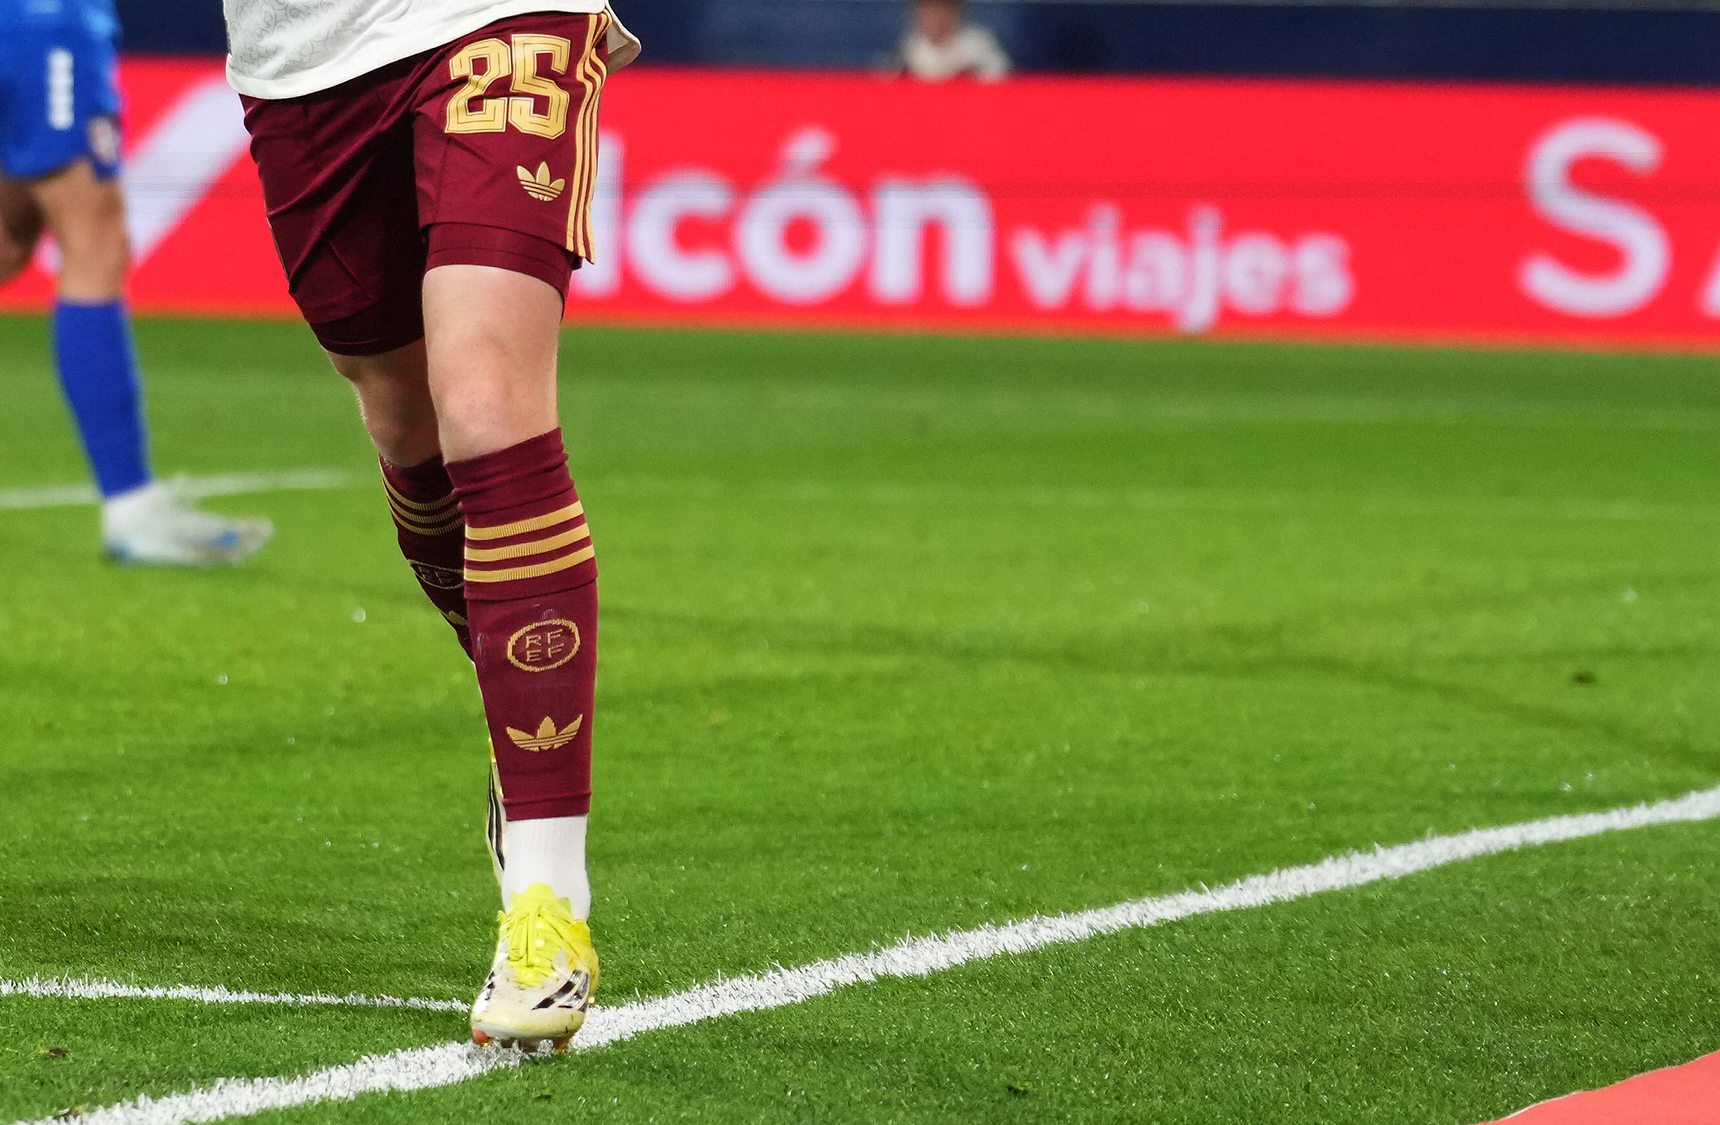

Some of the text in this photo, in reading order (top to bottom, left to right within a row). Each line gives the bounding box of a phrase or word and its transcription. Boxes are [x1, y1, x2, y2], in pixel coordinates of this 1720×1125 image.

[444, 33, 571, 140] 25
[570, 128, 1356, 334] lcón viajes
[1519, 118, 1720, 318] S
